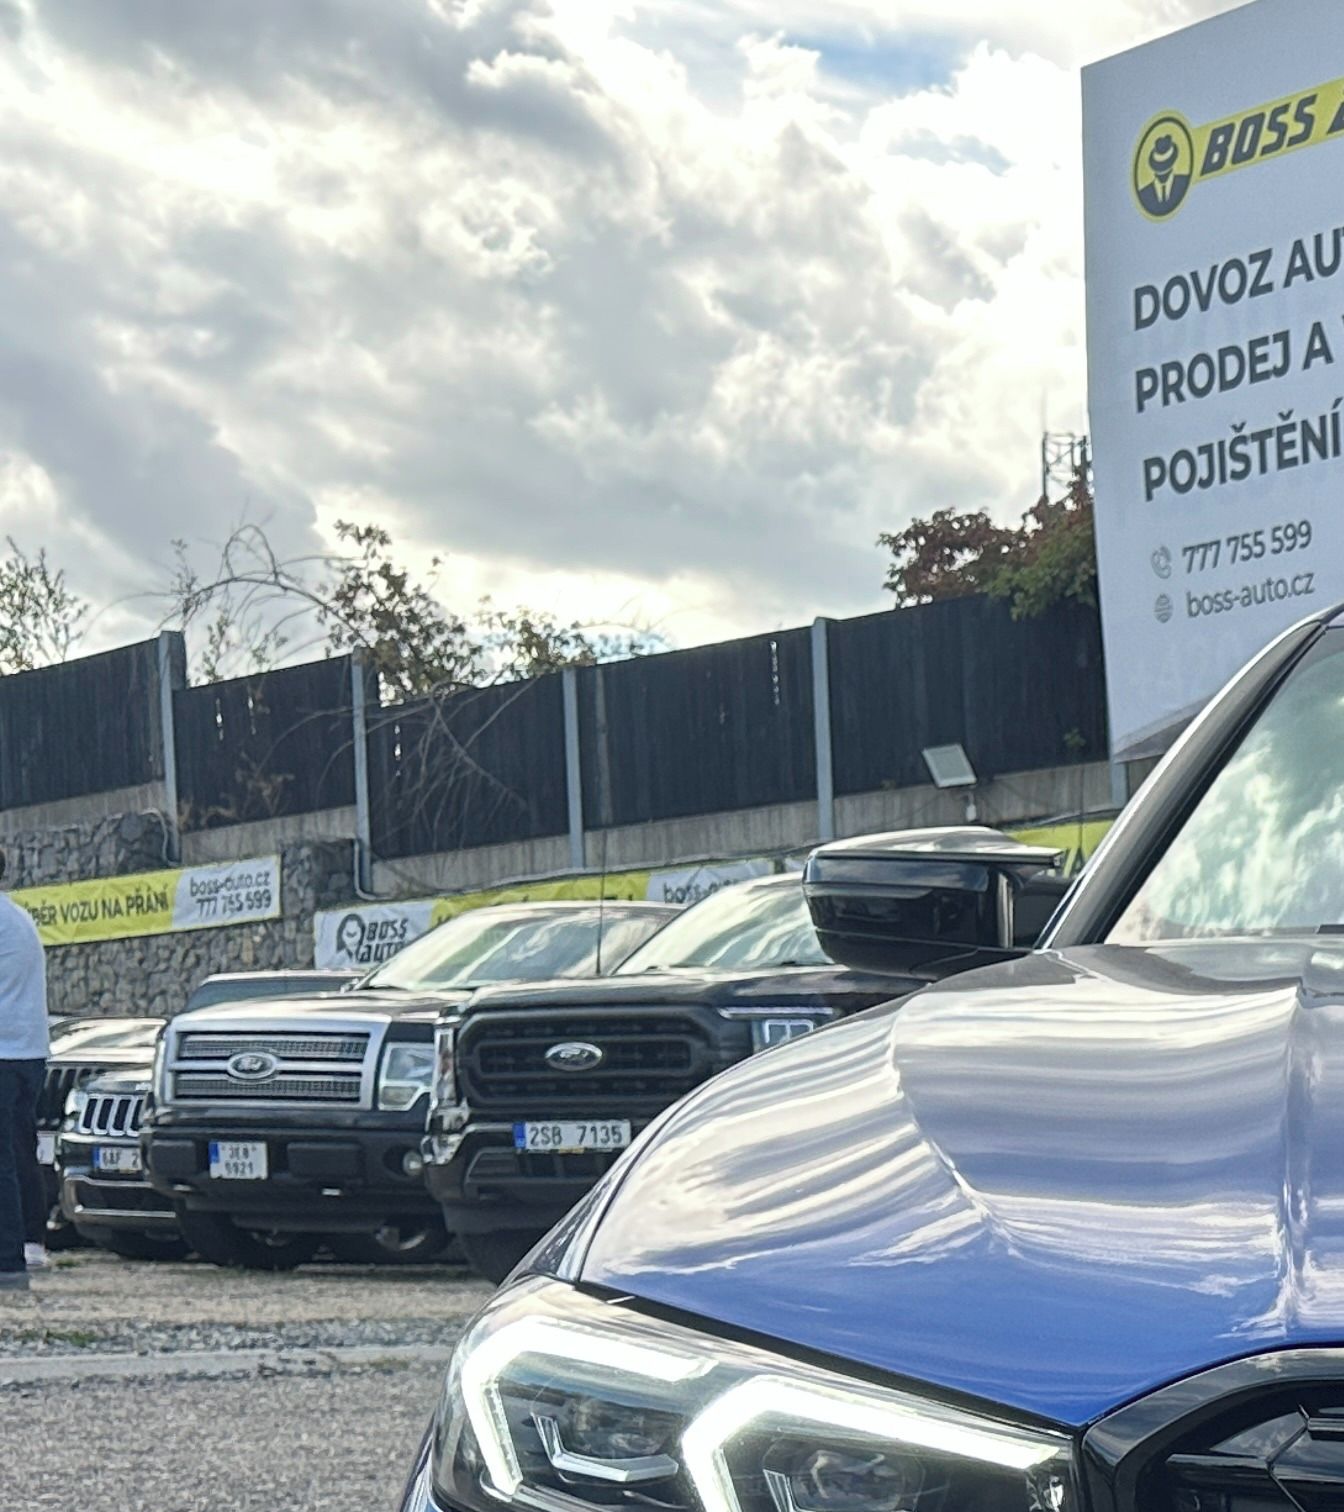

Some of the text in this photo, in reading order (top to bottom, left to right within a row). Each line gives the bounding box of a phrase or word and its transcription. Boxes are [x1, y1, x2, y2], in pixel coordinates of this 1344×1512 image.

[1200, 94, 1318, 177] BOSS
[1134, 248, 1273, 330] DOVOZ
[1135, 329, 1290, 412] PRODEJ
[1302, 322, 1333, 370] A
[1143, 397, 1344, 501] POJIŠTĚNÍ
[1182, 520, 1312, 574] 777 755 599
[1186, 573, 1315, 618] boss-auto.cz
[60, 899, 98, 923] VOZU
[101, 897, 124, 920] NA
[126, 883, 169, 916] PŘÁNÍ
[190, 872, 271, 898] boss-auto.cz
[367, 918, 409, 941] BOSS
